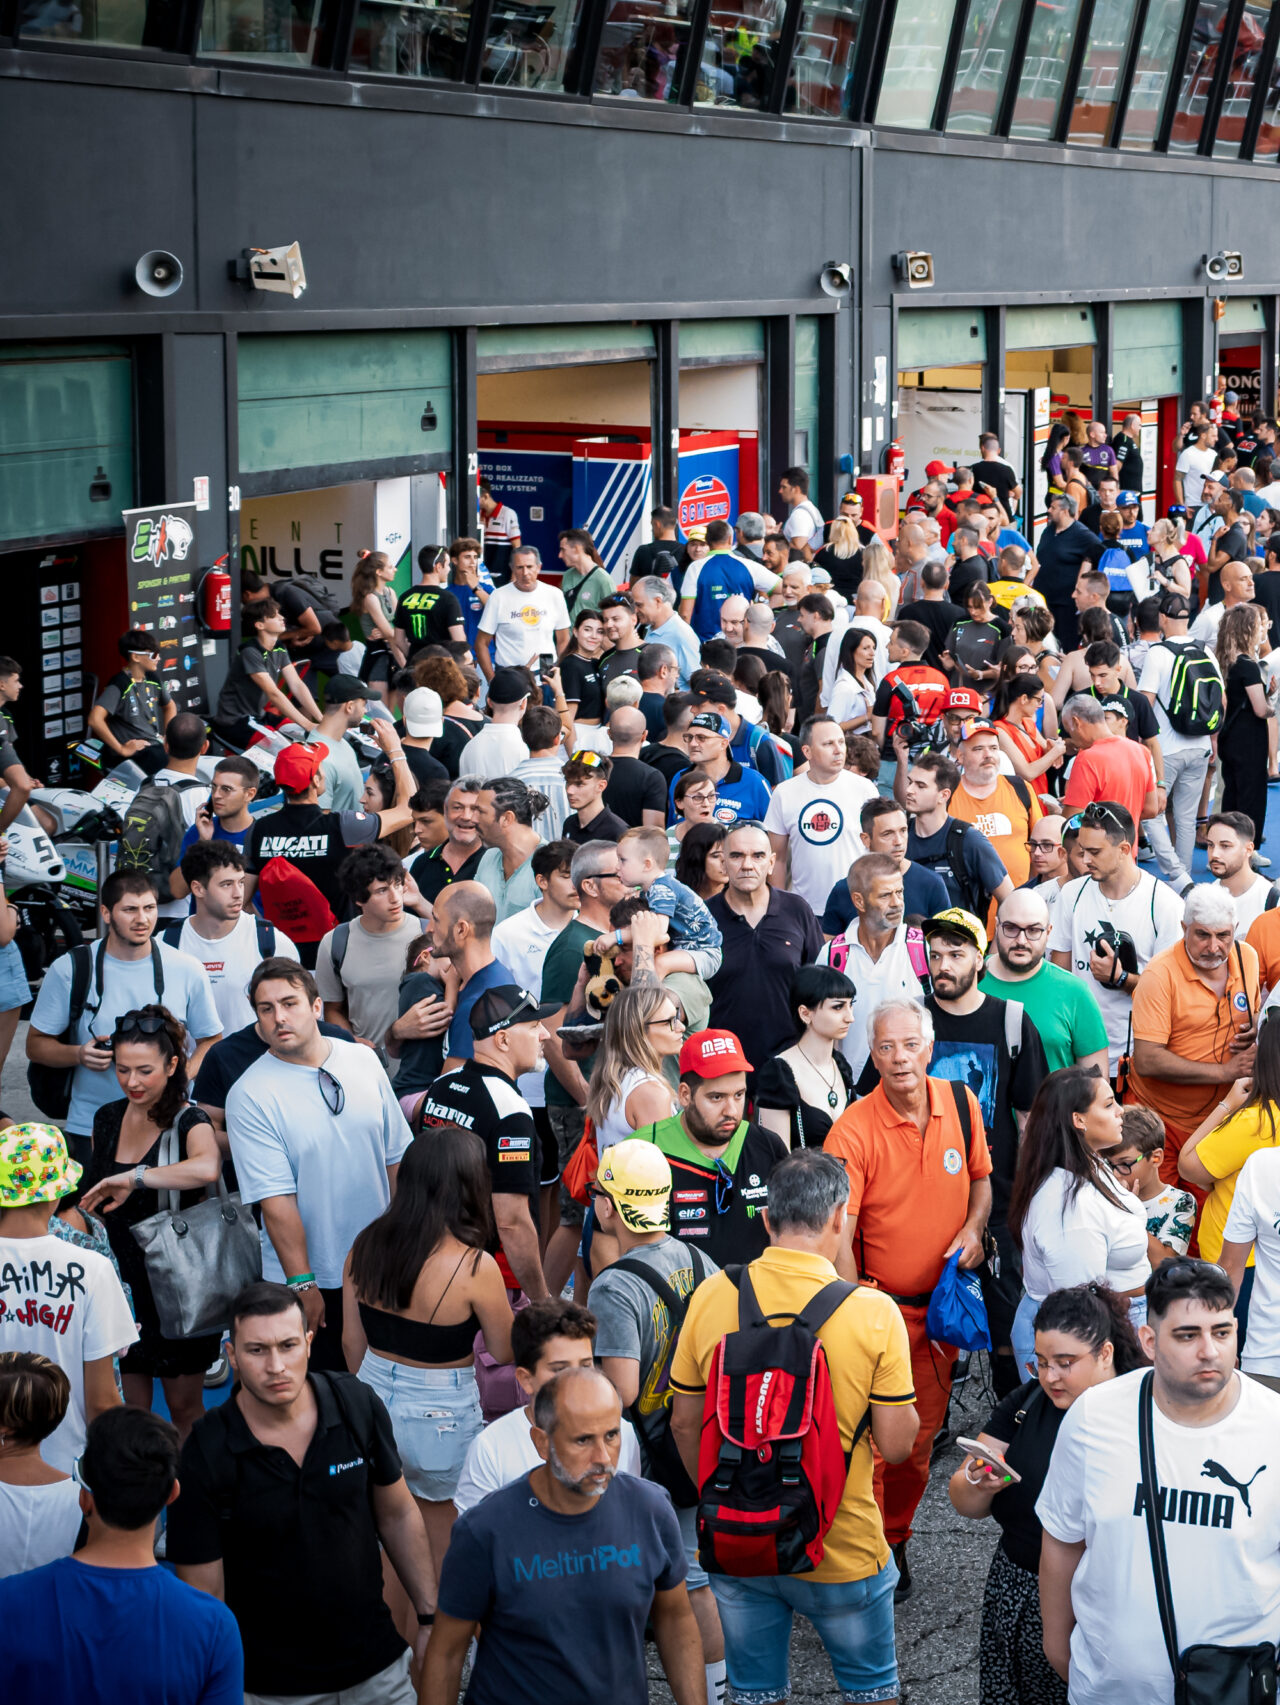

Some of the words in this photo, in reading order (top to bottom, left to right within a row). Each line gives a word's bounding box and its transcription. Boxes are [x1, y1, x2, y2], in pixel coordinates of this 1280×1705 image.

[228, 485, 242, 511] 30
[402, 593, 440, 610] 46
[260, 835, 329, 851] DUCATI
[756, 1371, 773, 1434] DUCATI
